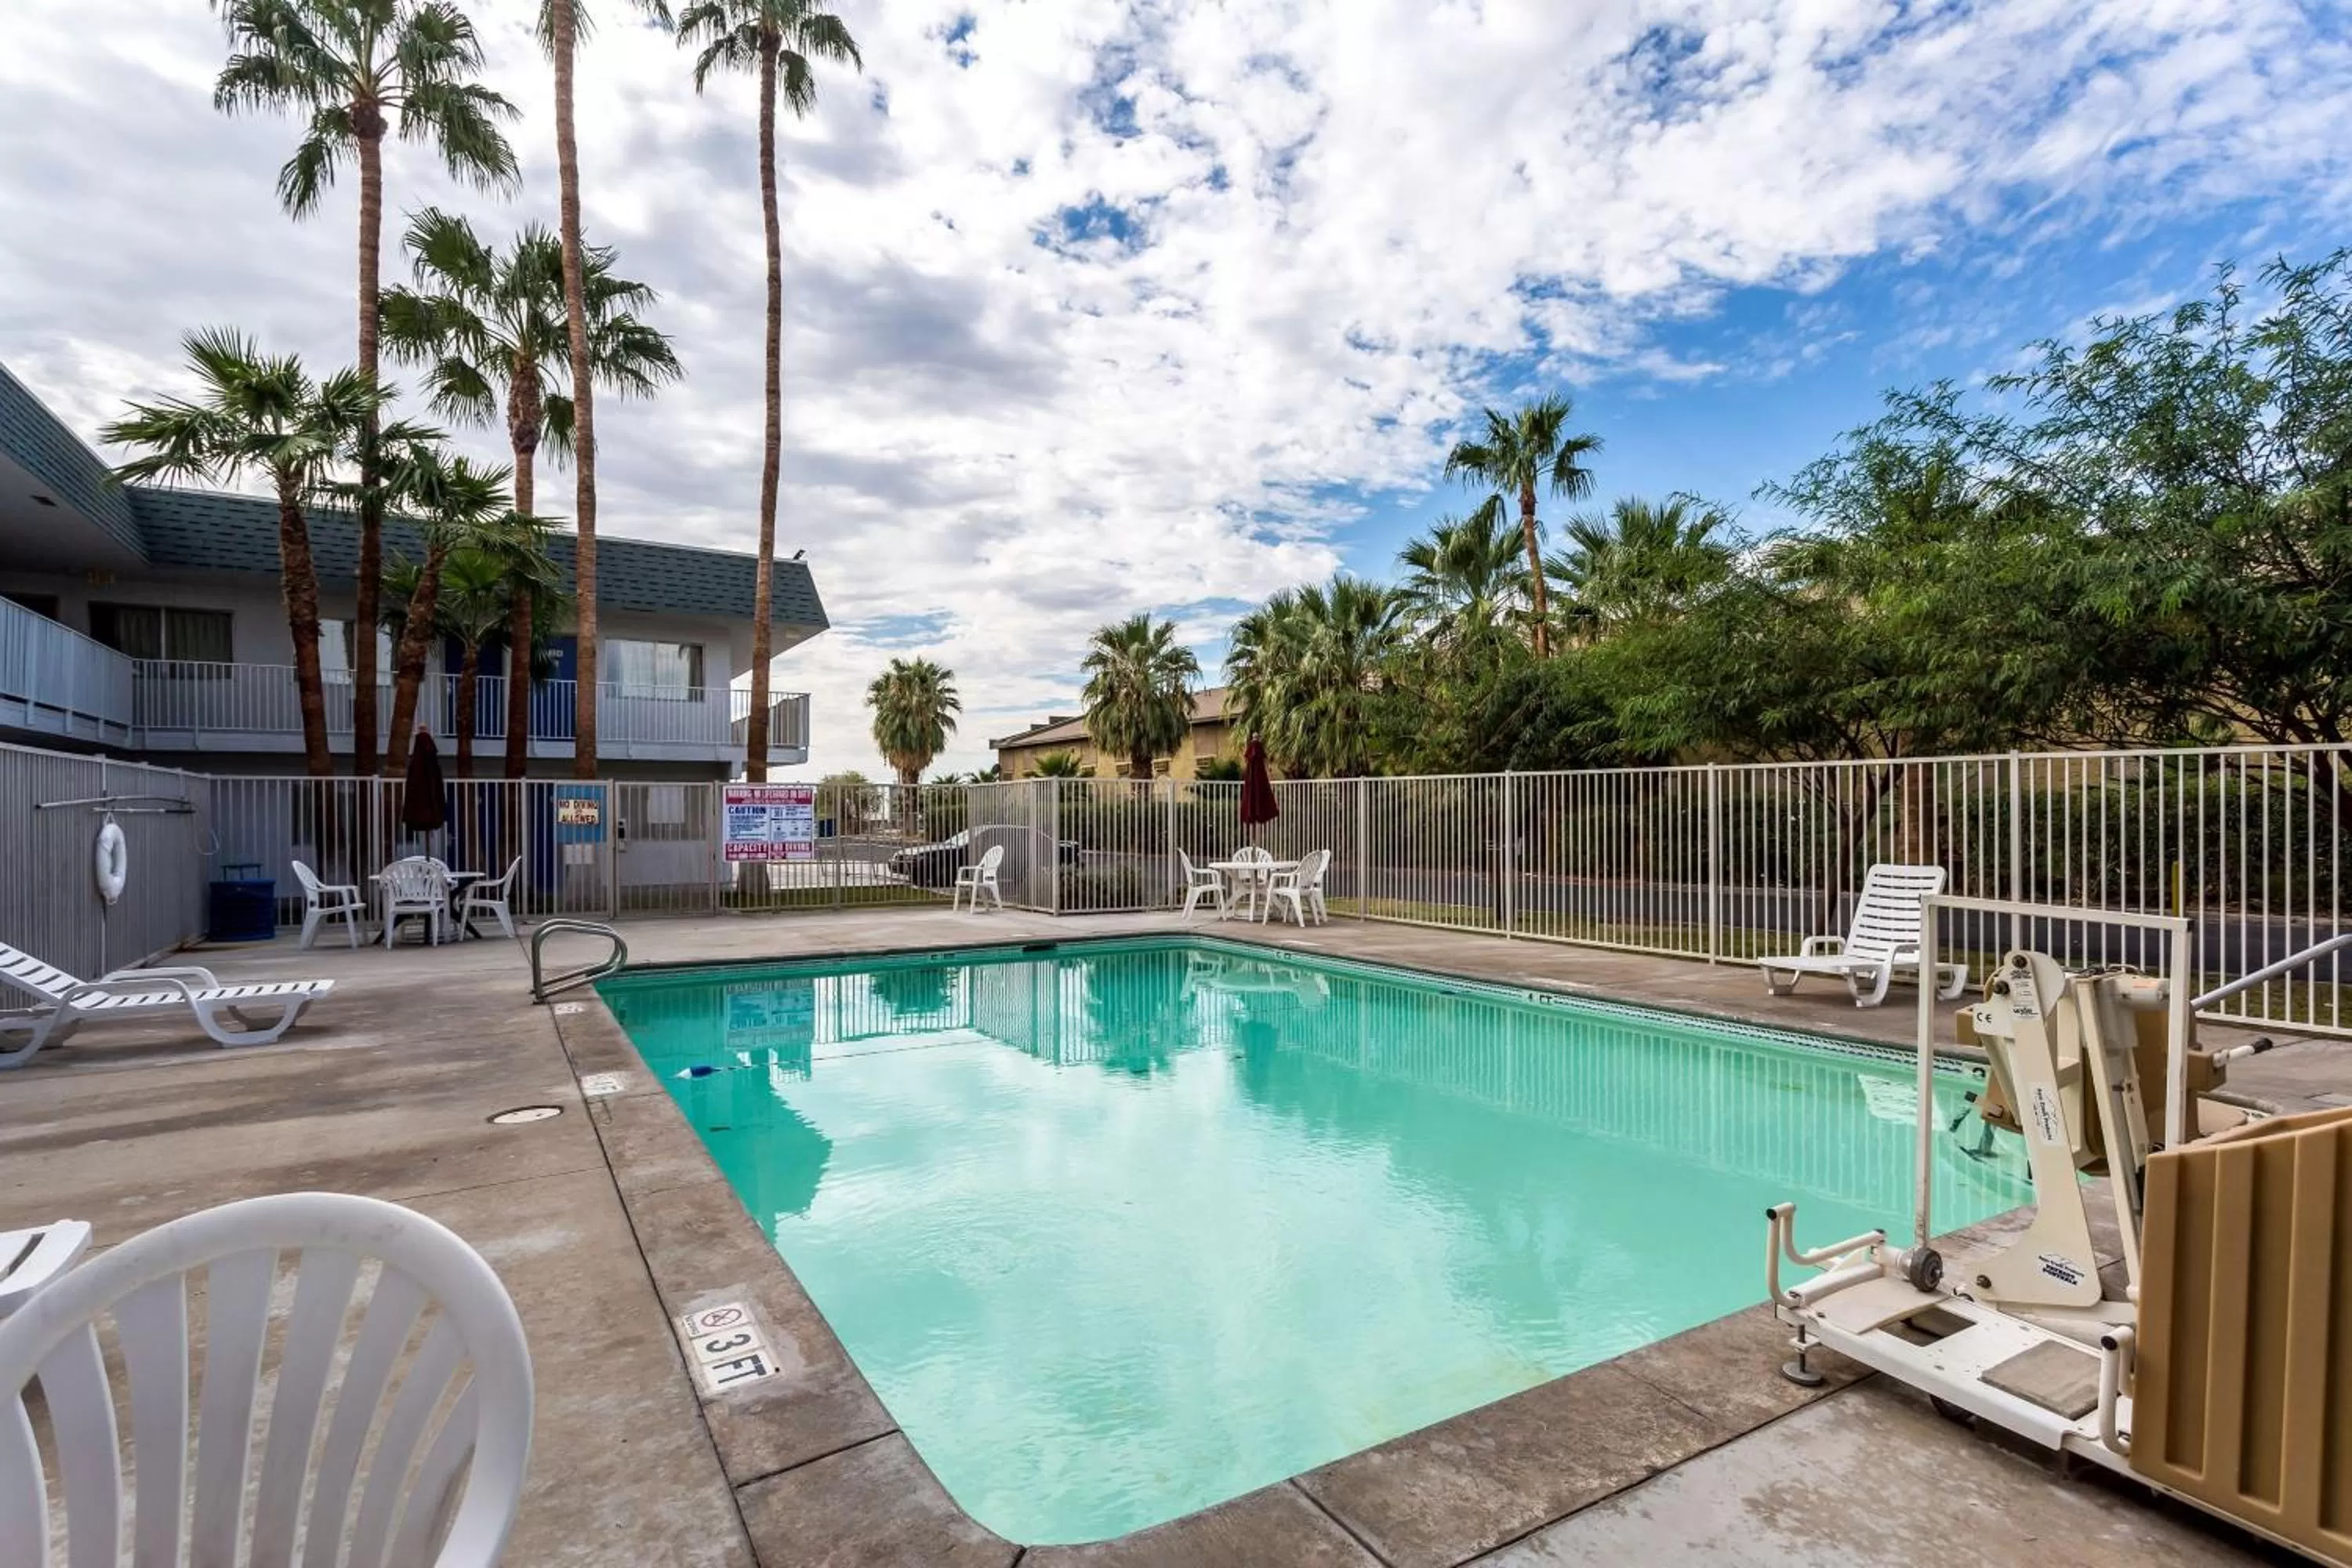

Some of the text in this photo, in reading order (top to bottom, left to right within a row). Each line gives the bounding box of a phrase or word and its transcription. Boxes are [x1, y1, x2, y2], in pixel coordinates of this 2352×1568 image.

[574, 800, 598, 809] DIVING
[728, 806, 766, 815] CAUTION
[727, 843, 768, 852] CAPACITY
[785, 843, 810, 852] DIVING
[1976, 1012, 1992, 1023] CE
[706, 1334, 767, 1384] 3 FT
